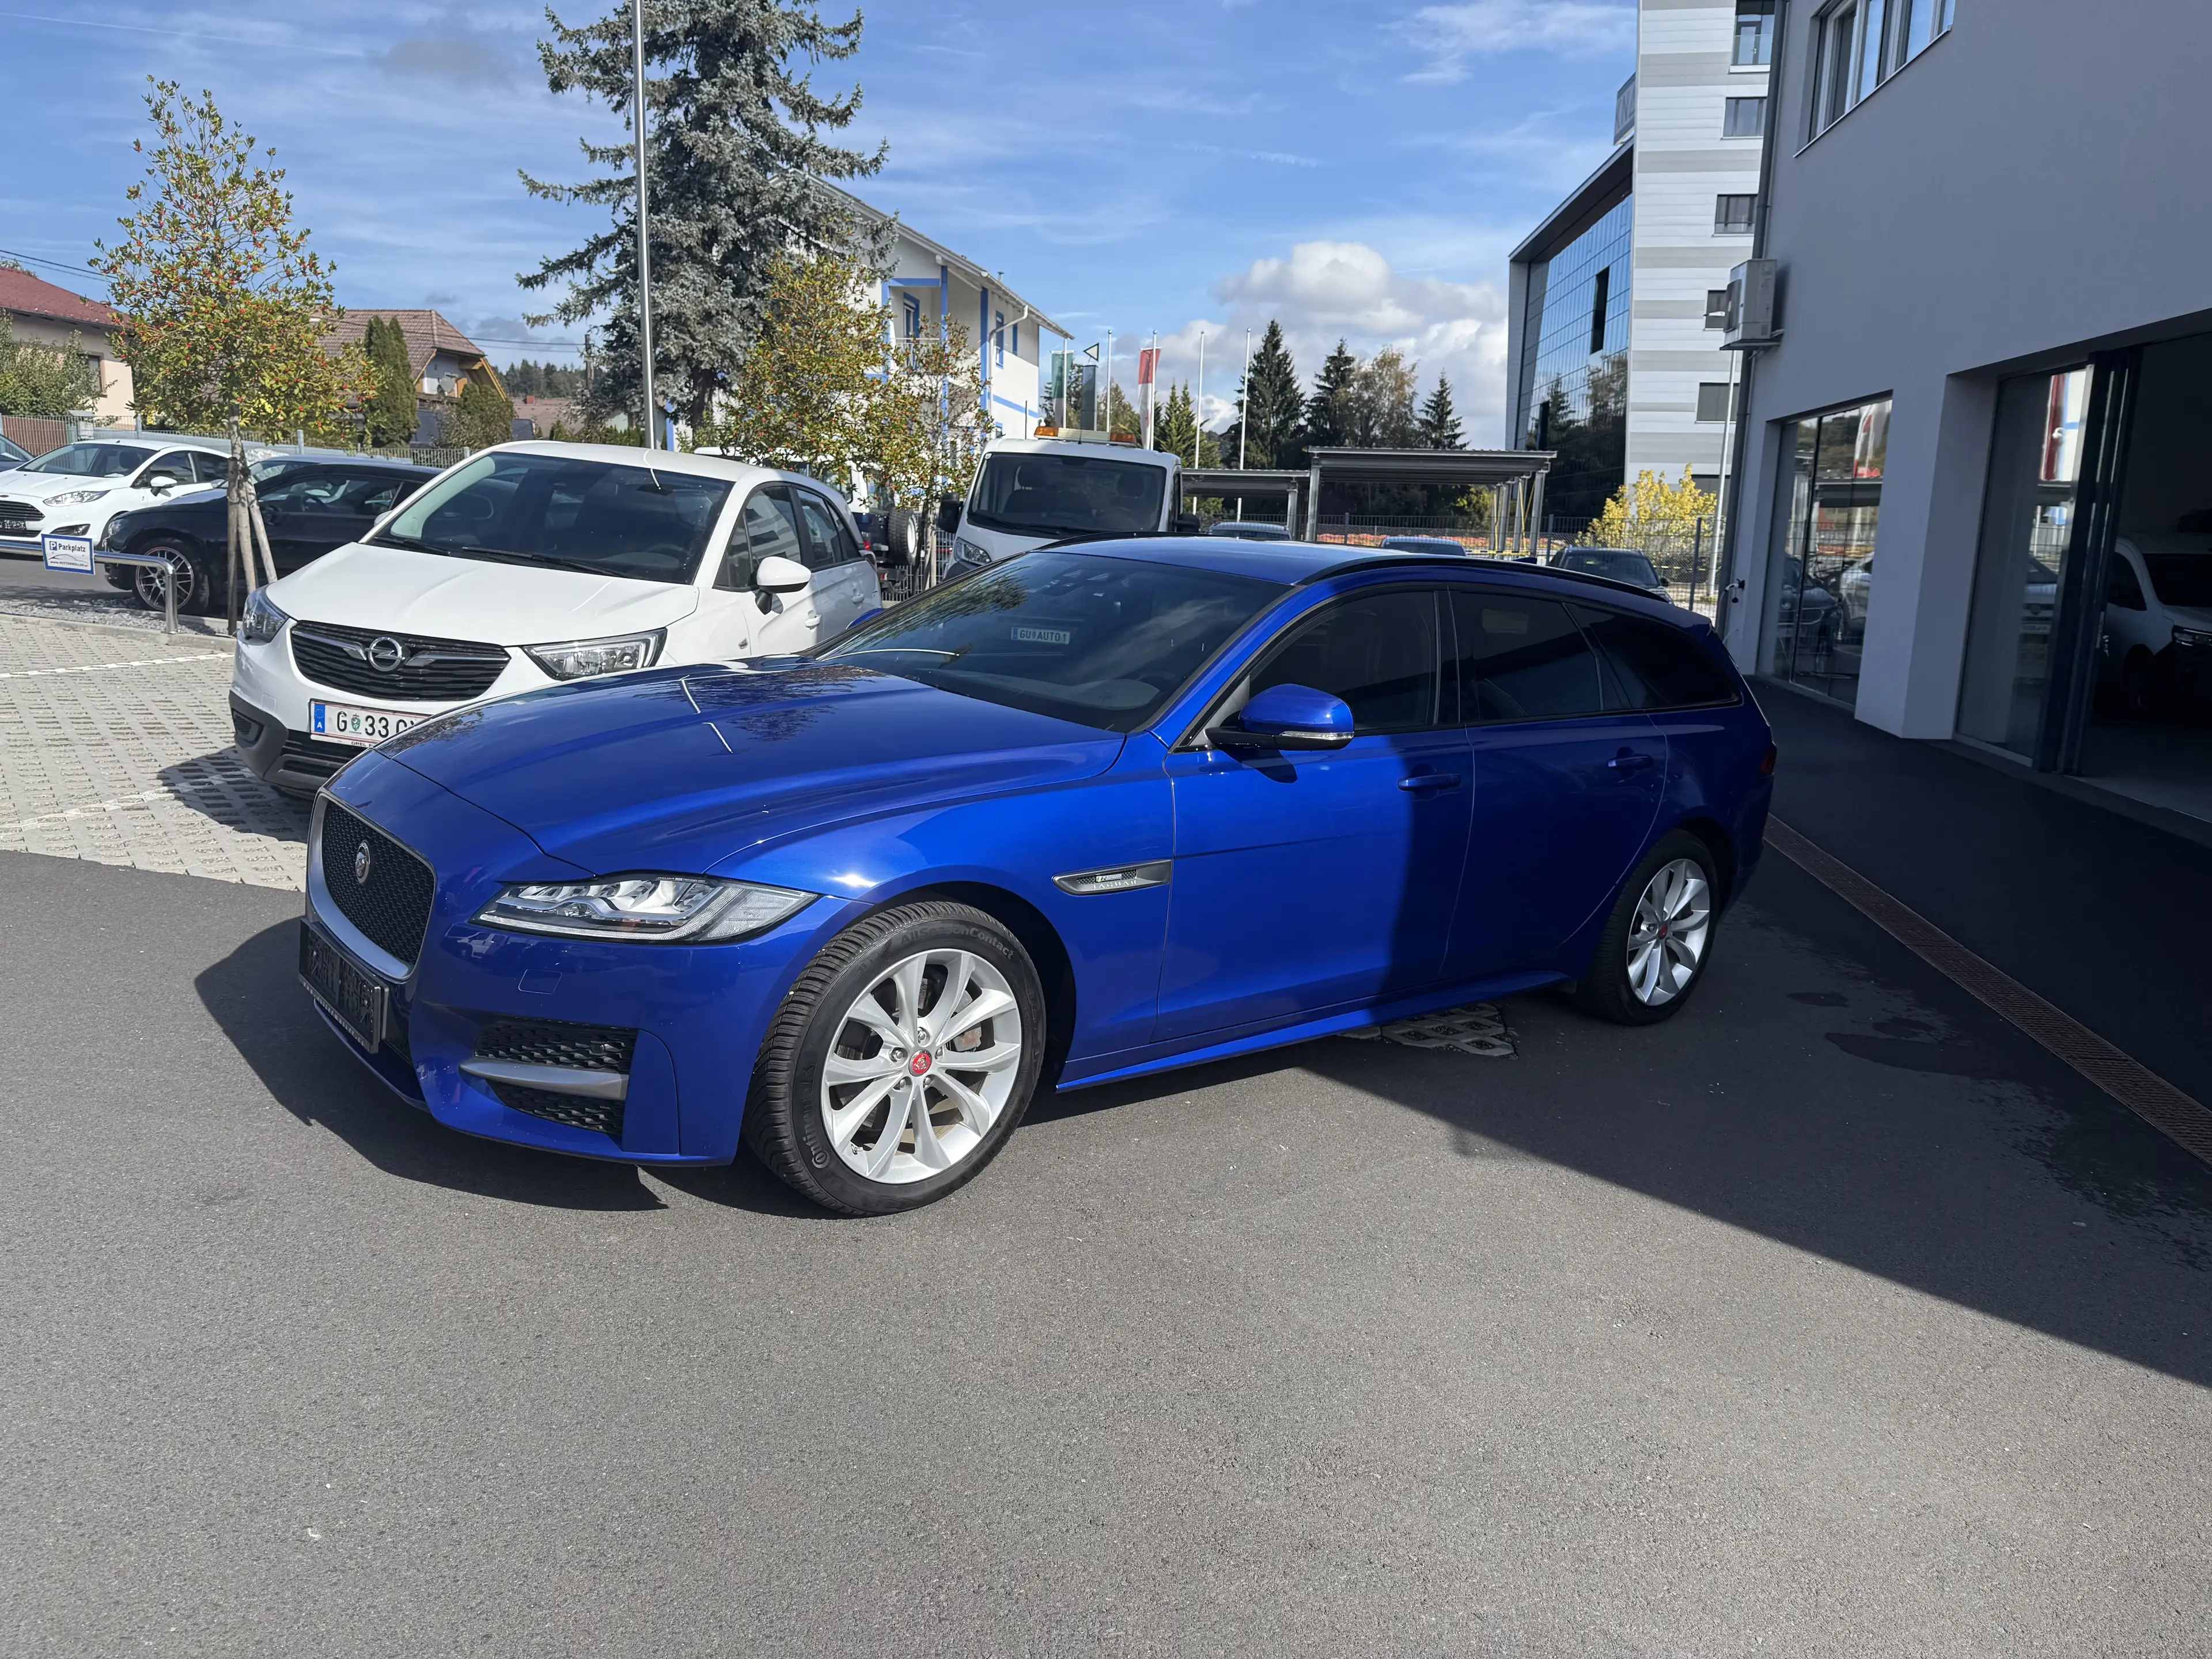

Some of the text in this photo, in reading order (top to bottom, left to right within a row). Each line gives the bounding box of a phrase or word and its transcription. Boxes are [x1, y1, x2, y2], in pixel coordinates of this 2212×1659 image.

[58, 543, 86, 552] Parkplatz
[1020, 630, 1031, 639] GU
[1037, 631, 1060, 641] AUTO
[316, 721, 323, 729] A
[337, 711, 347, 732] G
[365, 715, 389, 738] 33
[1093, 880, 1137, 889] JAGUAR
